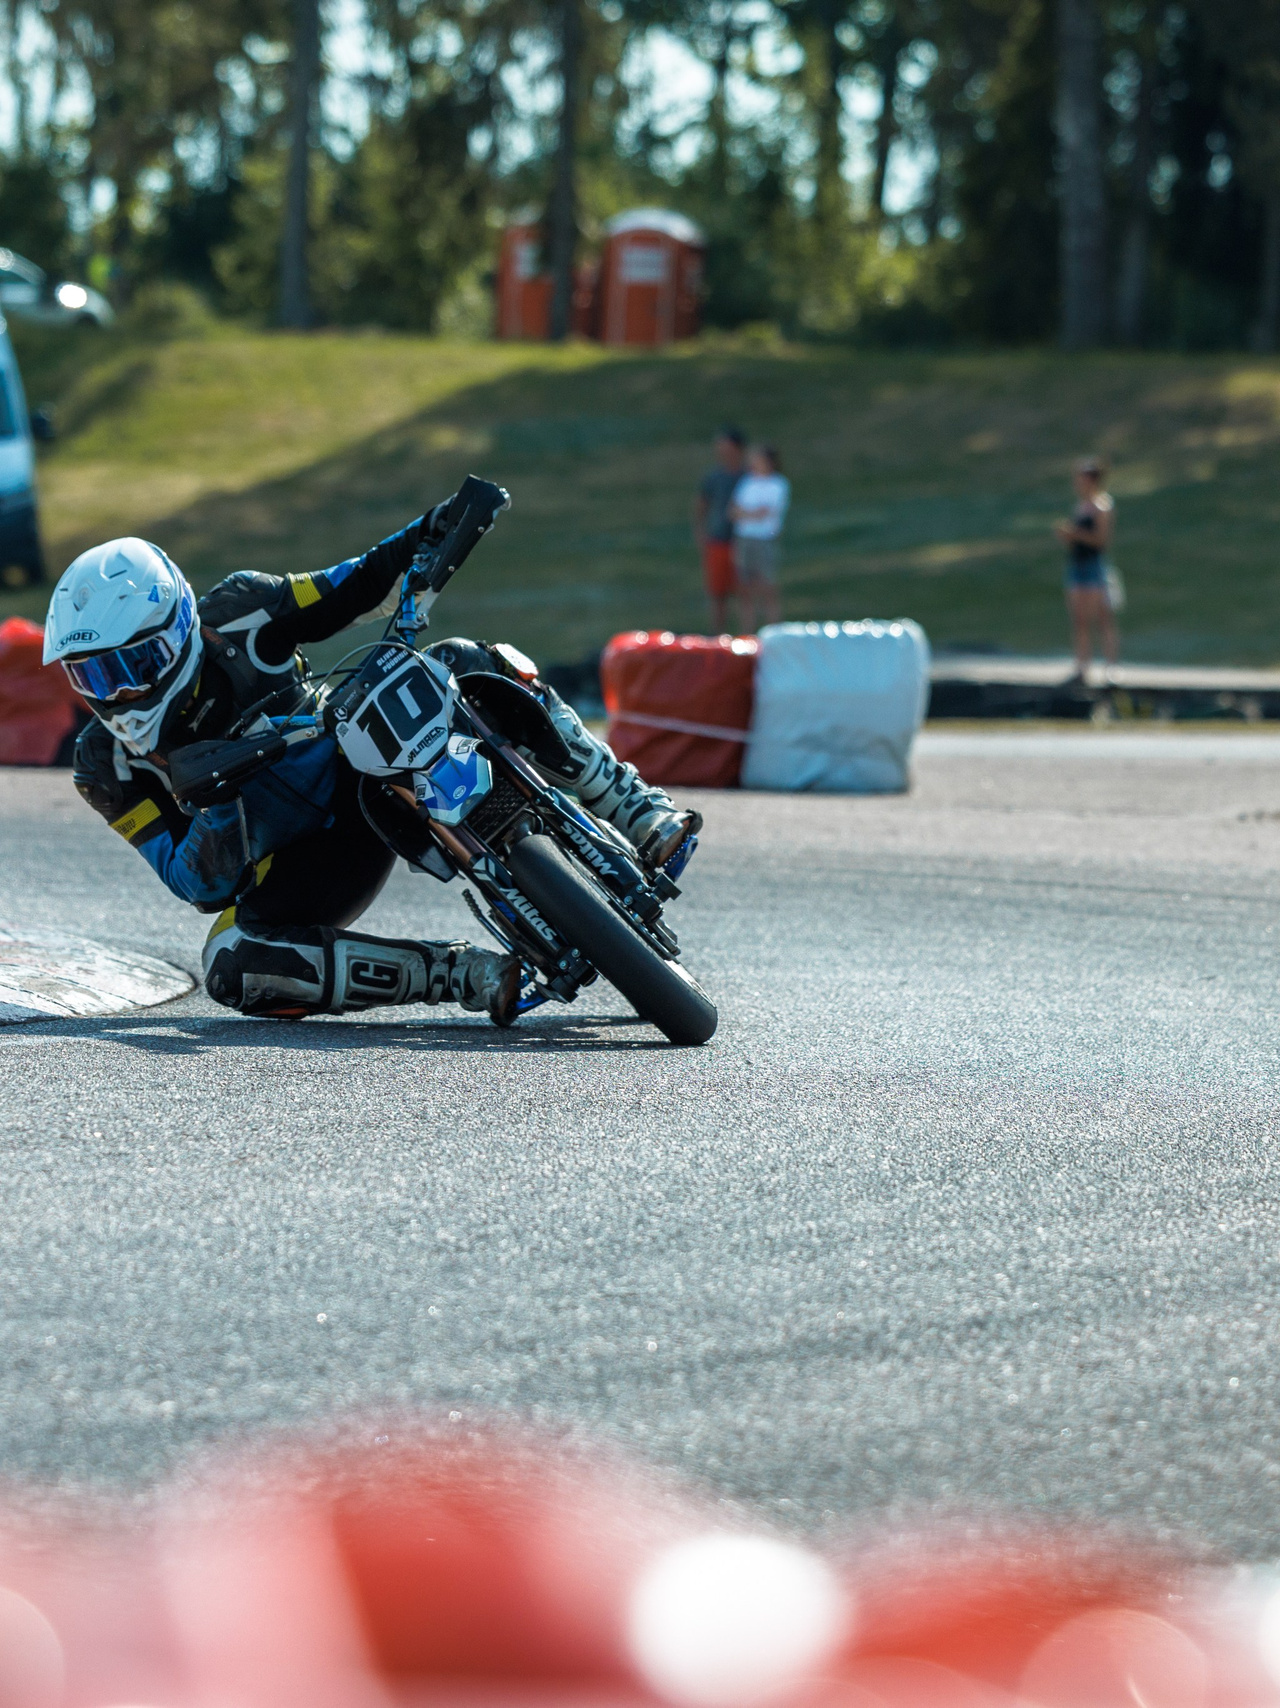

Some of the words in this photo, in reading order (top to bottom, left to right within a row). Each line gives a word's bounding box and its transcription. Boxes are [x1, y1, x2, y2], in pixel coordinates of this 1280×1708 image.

[60, 631, 93, 647] SHOEI
[376, 647, 397, 667] OLIVER
[356, 665, 443, 767] 10
[560, 821, 619, 876] Mitas
[499, 887, 557, 941] Mitas
